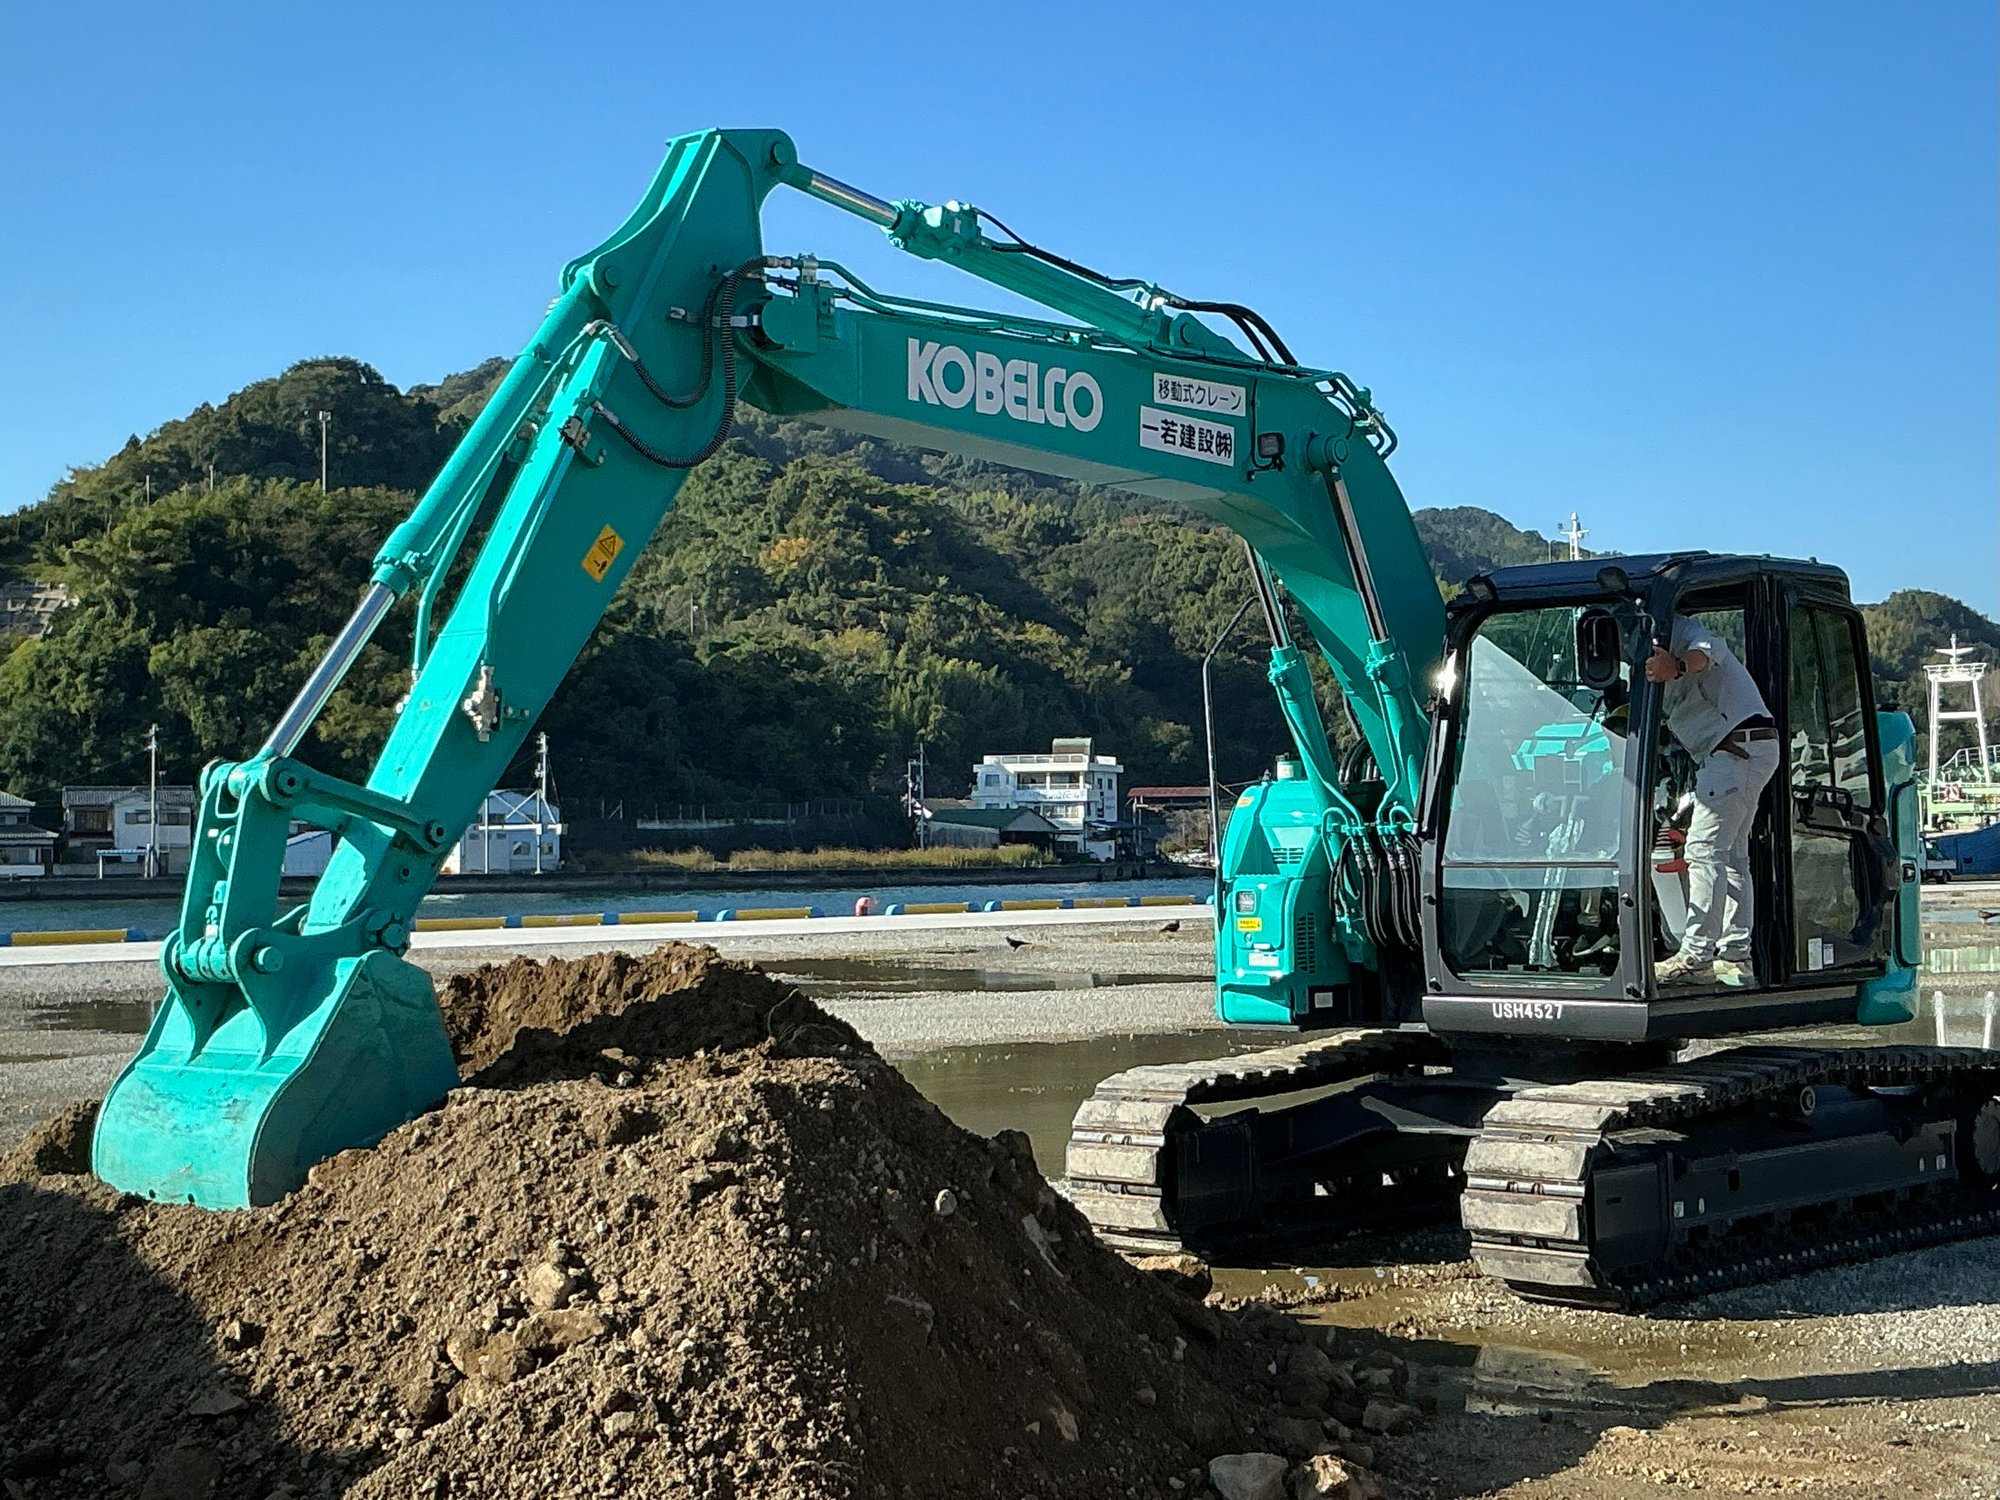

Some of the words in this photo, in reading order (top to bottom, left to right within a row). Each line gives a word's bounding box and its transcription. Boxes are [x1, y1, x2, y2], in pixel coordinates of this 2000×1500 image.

[907, 337, 1103, 432] KOBELCO
[1158, 378, 1241, 410] 移動式クレーン
[1492, 1002, 1563, 1019] USH4527
